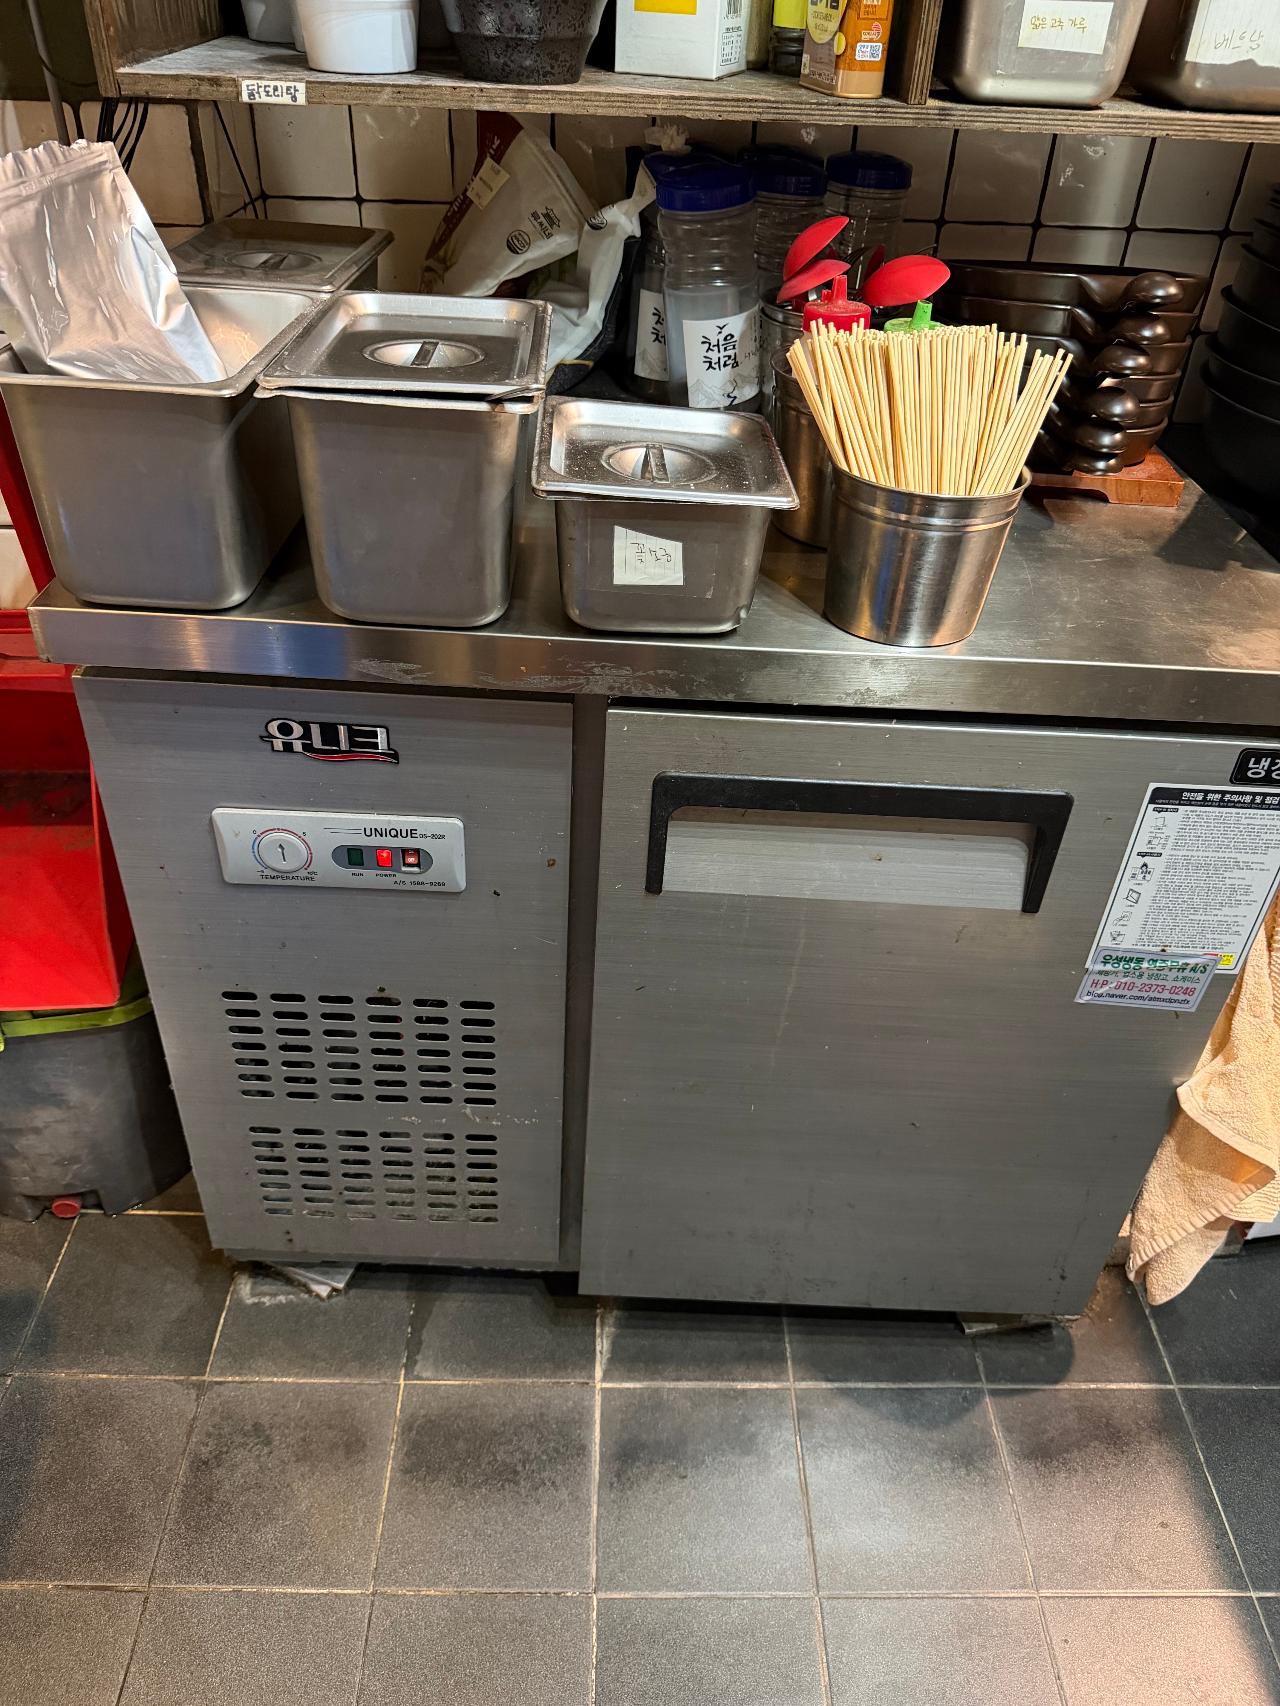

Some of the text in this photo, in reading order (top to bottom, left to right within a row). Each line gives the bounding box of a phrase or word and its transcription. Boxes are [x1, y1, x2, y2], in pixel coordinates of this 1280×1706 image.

[1068, 17, 1088, 34] 가루
[245, 82, 300, 103] 닭도리탕
[700, 332, 738, 354] 처음
[702, 352, 740, 372] 처럼
[262, 719, 396, 754] 유니크
[1181, 791, 1205, 801] 안전을
[1206, 793, 1222, 802] 위한
[1223, 794, 1253, 804] 주의사항
[1254, 795, 1263, 804] 및
[363, 827, 418, 839] UNIQUE
[260, 874, 316, 882] TEMPERATURE
[1101, 954, 1145, 971] 우성냉동
[1189, 962, 1209, 974] A/S
[1114, 980, 1197, 997] 010-2373-0248
